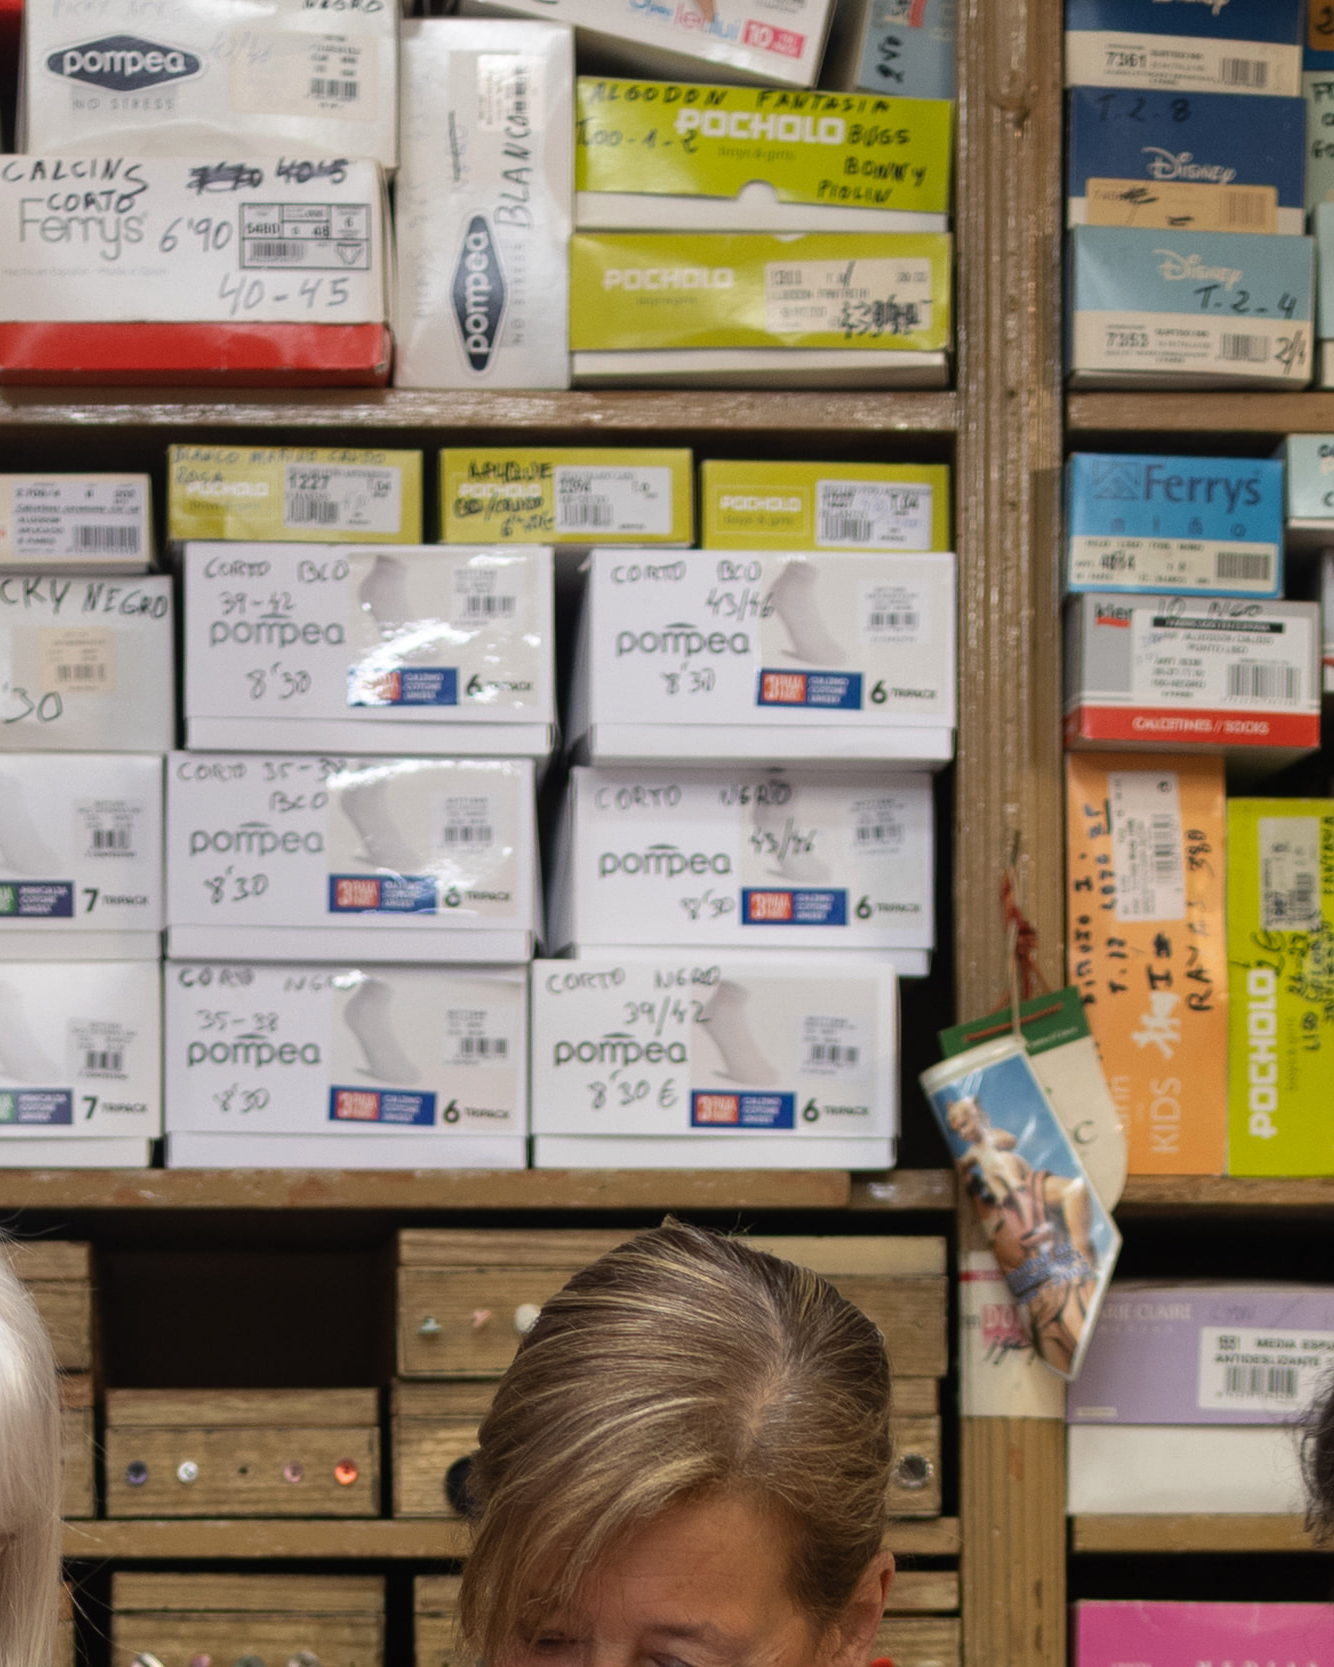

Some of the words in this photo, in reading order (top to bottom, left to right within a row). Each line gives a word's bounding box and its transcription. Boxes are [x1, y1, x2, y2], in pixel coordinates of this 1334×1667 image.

[63, 49, 187, 78] pompea
[674, 108, 846, 145] POCHOLO
[18, 198, 144, 261] Ferrys
[464, 229, 490, 356] pompea
[602, 266, 736, 292] POCHOLO
[719, 495, 801, 512] POCHOLO
[1142, 464, 1264, 513] Ferrys
[82, 582, 168, 619] NEGRO
[209, 613, 346, 647] pompea
[615, 623, 751, 657] pompea
[870, 680, 888, 705] 6
[1132, 716, 1213, 733] CALCETINES
[1224, 720, 1270, 734] SOCKS
[188, 822, 325, 858] pompea
[598, 843, 732, 880] pompea
[82, 888, 100, 913] 7
[855, 896, 874, 920] 6
[187, 1032, 322, 1069] pompea
[554, 1032, 688, 1068] pompea
[1247, 968, 1278, 1140] POCHOLO
[82, 1096, 99, 1121] 7
[443, 1100, 461, 1124] 6
[802, 1100, 820, 1123] 6
[1151, 1075, 1181, 1154] KIDS
